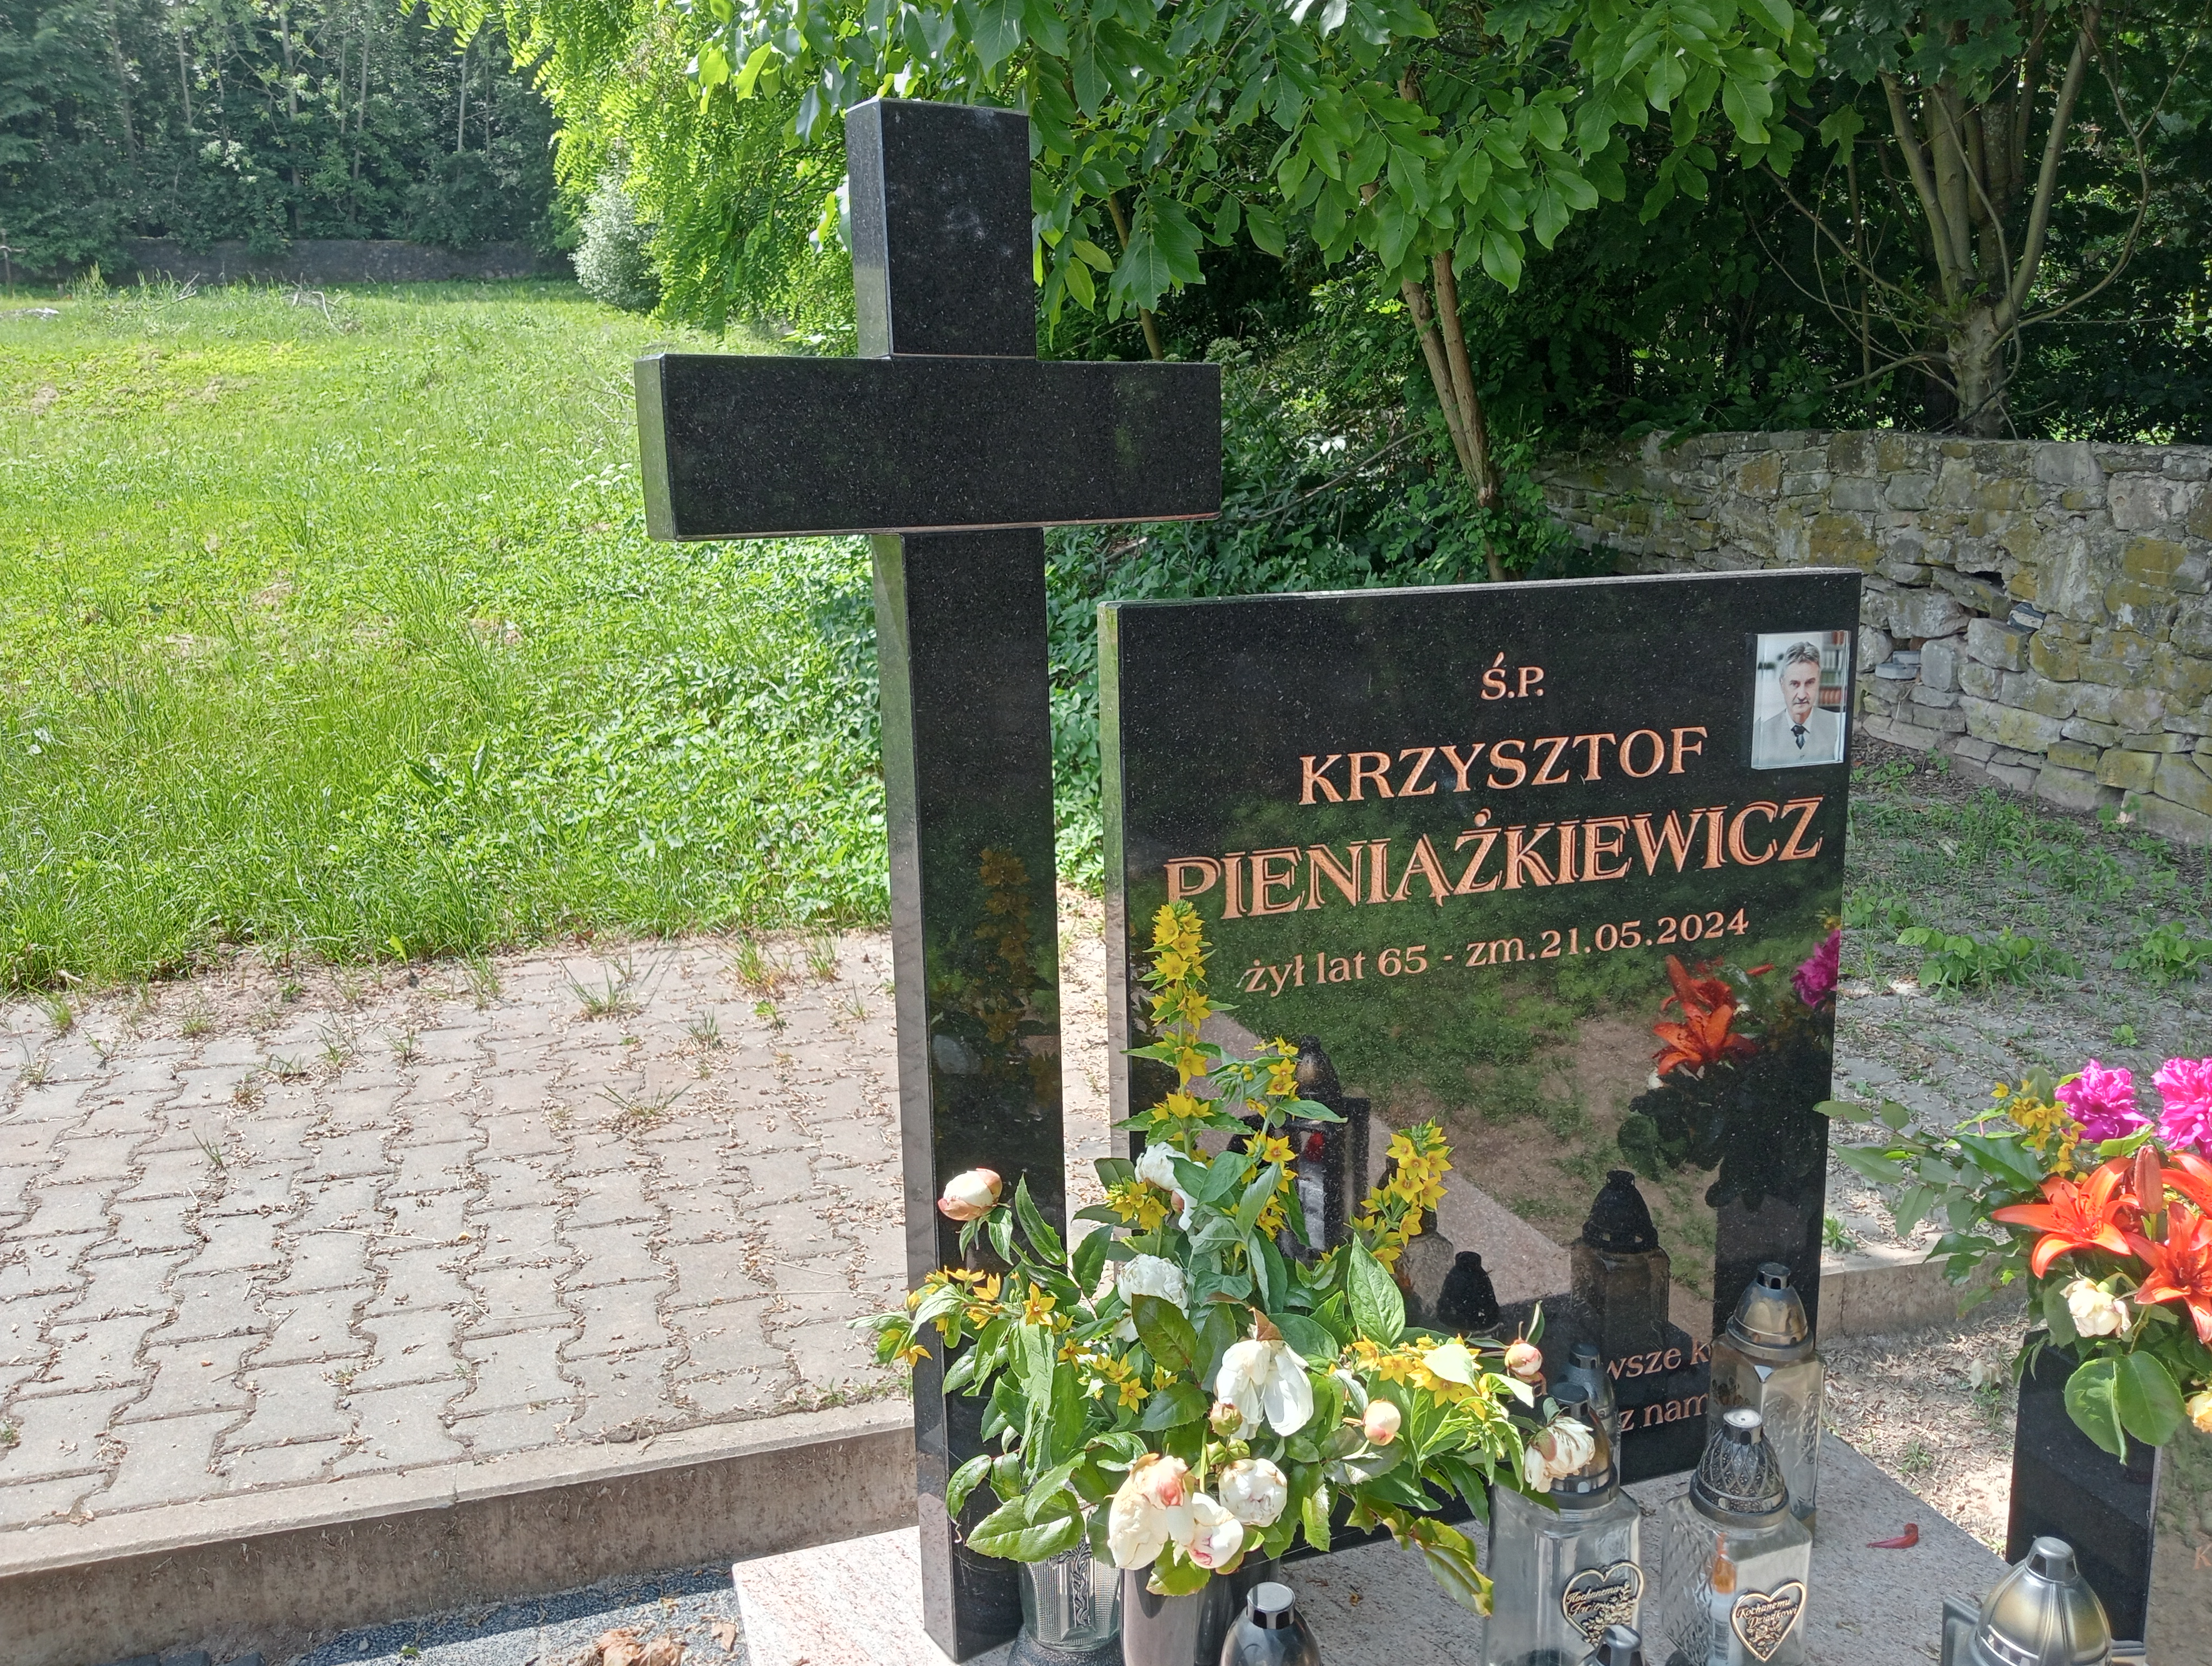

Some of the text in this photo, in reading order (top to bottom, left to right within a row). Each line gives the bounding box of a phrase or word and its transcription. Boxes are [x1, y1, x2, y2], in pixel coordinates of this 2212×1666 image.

[1481, 651, 1545, 701] Ś.P.
[1298, 726, 1708, 806] KRZYSZTOF
[1163, 795, 1825, 920] PIENIĄŻKIEWICZ
[1244, 953, 1305, 998] żył
[1316, 950, 1366, 984] lat
[1377, 945, 1428, 977] 65
[1465, 907, 1750, 967] zm.21.05.2024
[1737, 1598, 1791, 1619] Kochanemu
